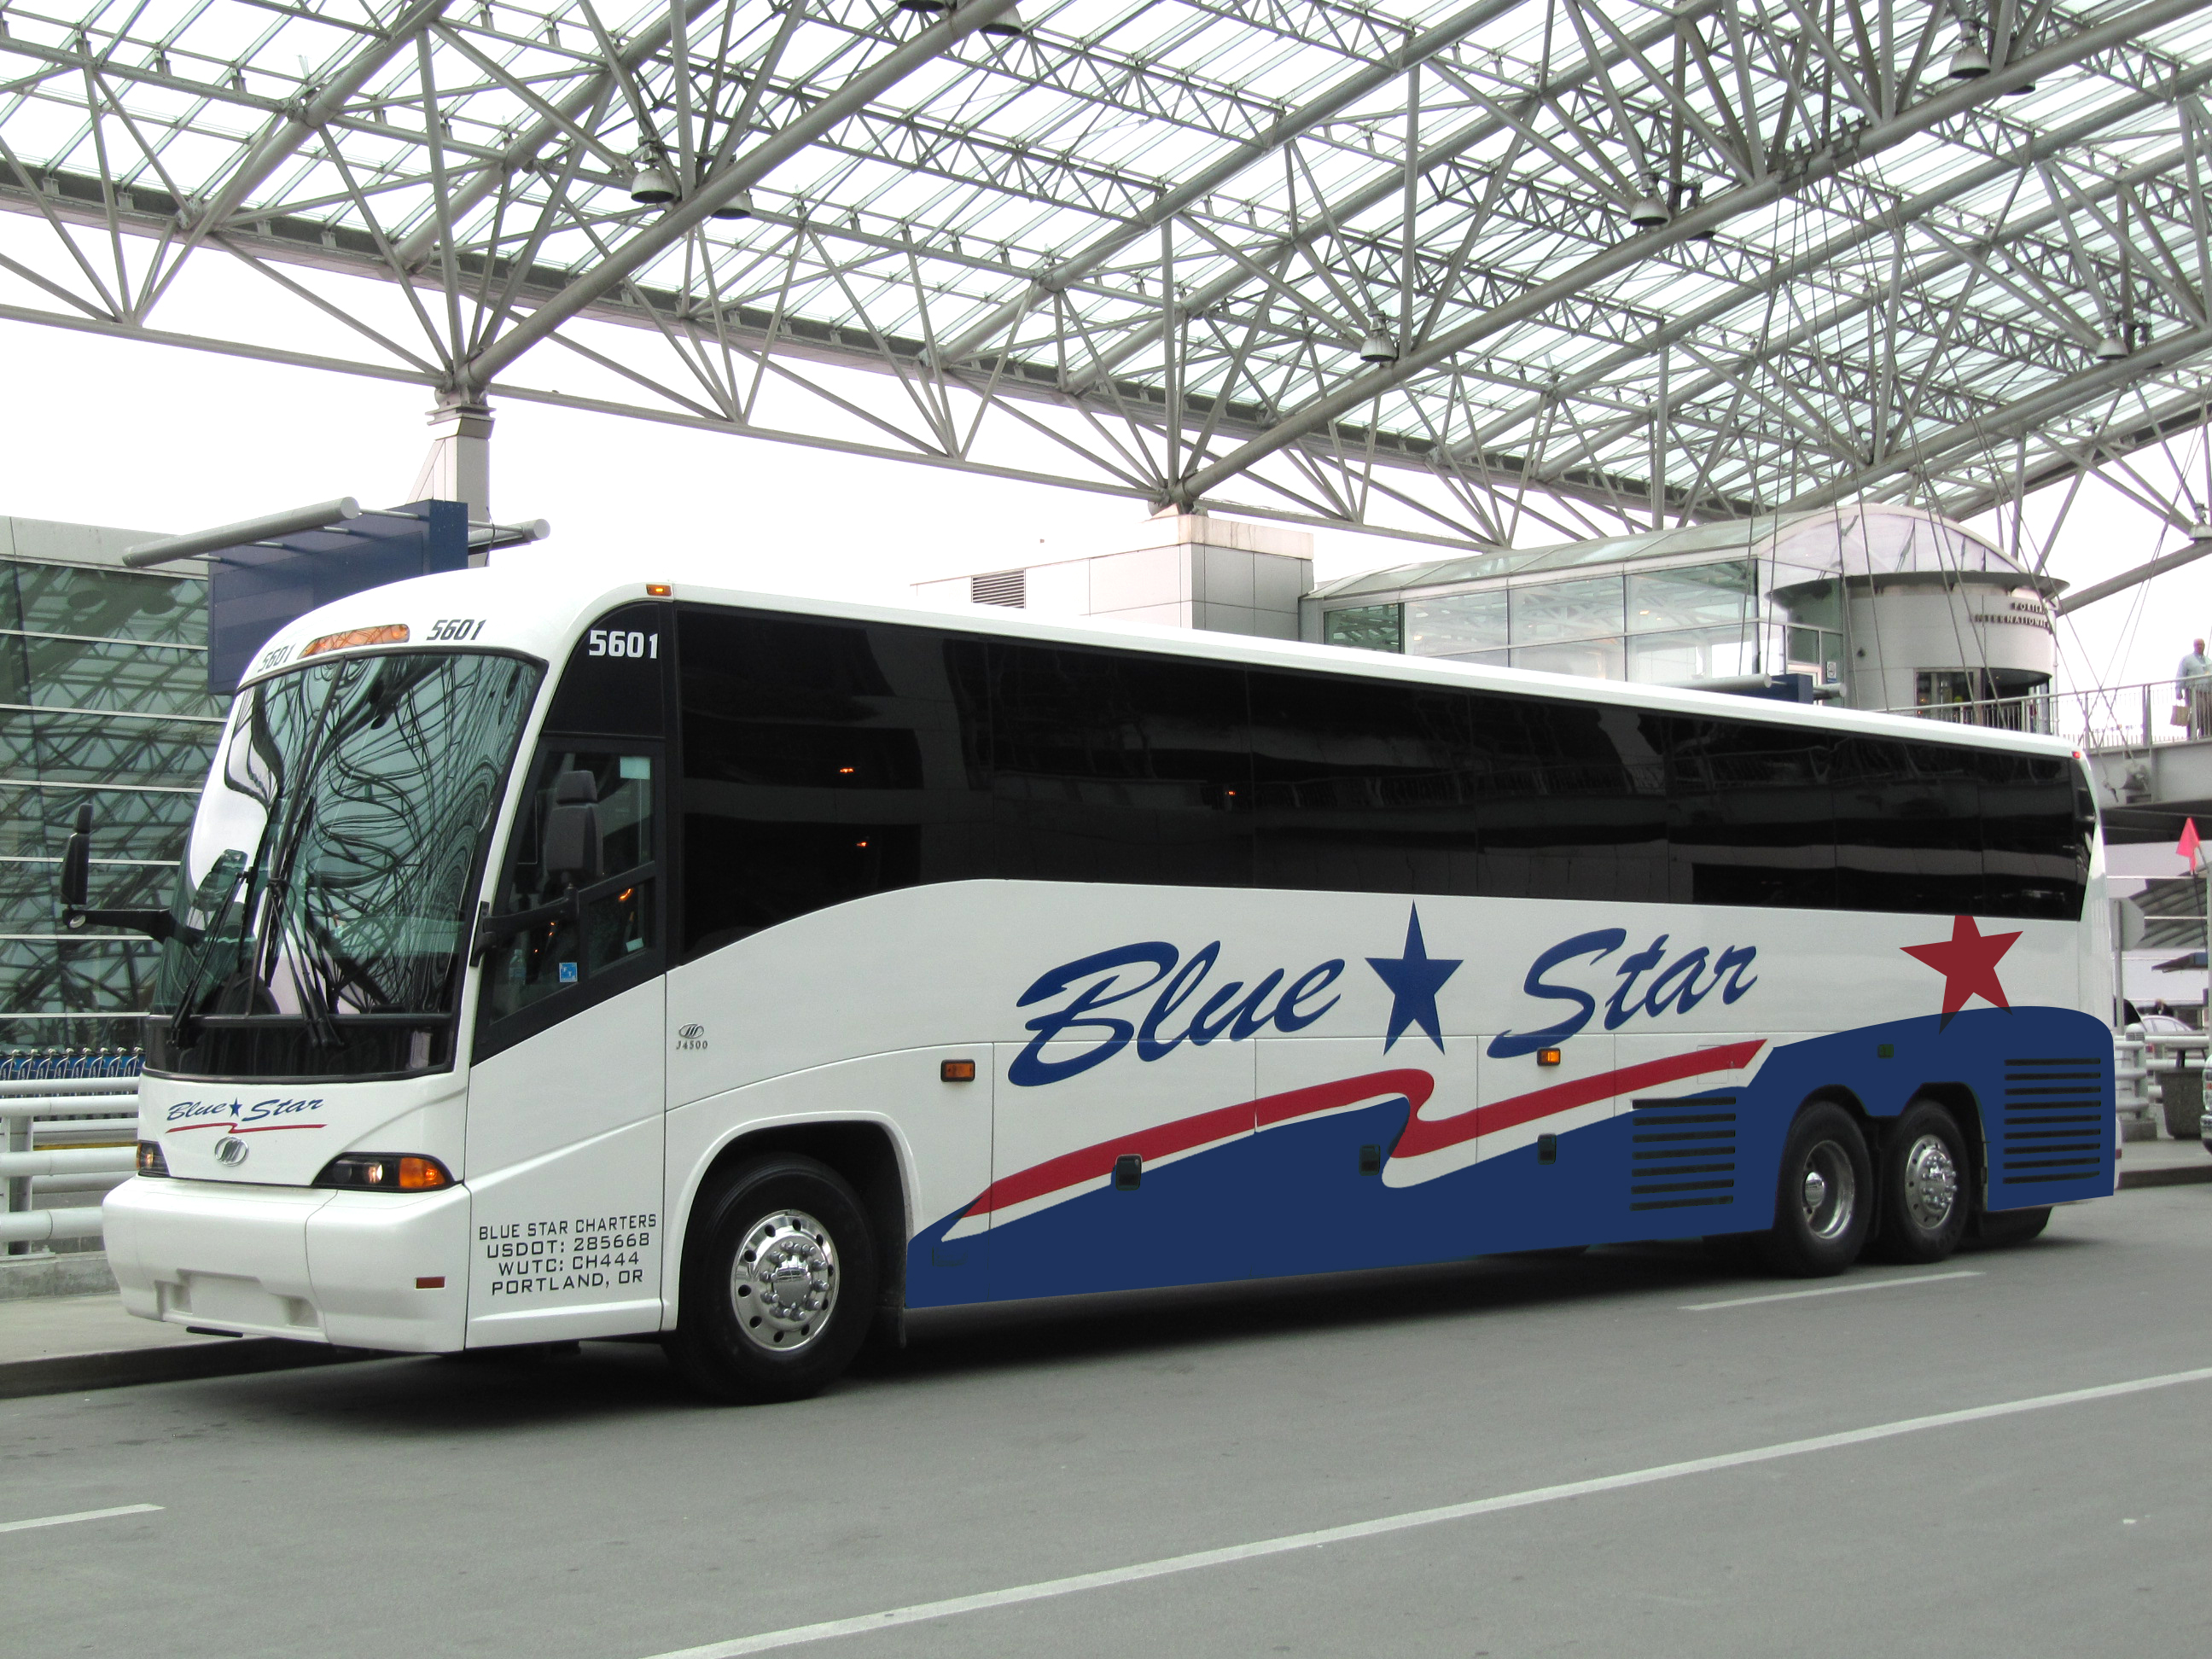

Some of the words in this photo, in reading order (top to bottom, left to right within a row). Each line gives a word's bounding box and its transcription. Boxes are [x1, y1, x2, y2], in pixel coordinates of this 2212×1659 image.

[2011, 602, 2048, 615] PORTLA
[426, 619, 487, 641] 5601
[258, 643, 297, 672] 5601
[588, 629, 659, 660] 5601
[1008, 940, 1347, 1087] Blue
[1487, 927, 1758, 1059] Star
[676, 1039, 708, 1051] J4500
[166, 1101, 228, 1121] Blue
[242, 1098, 324, 1121] Star
[479, 1223, 521, 1240] BLUE
[527, 1220, 568, 1237] STAR
[575, 1214, 656, 1233] CHARTERS
[487, 1240, 565, 1259] USDOT:
[573, 1232, 649, 1252] 285668
[498, 1259, 563, 1276] WUTC:
[573, 1251, 640, 1270] CH444
[492, 1272, 610, 1295] PORTLAND,
[619, 1269, 643, 1284] OR
